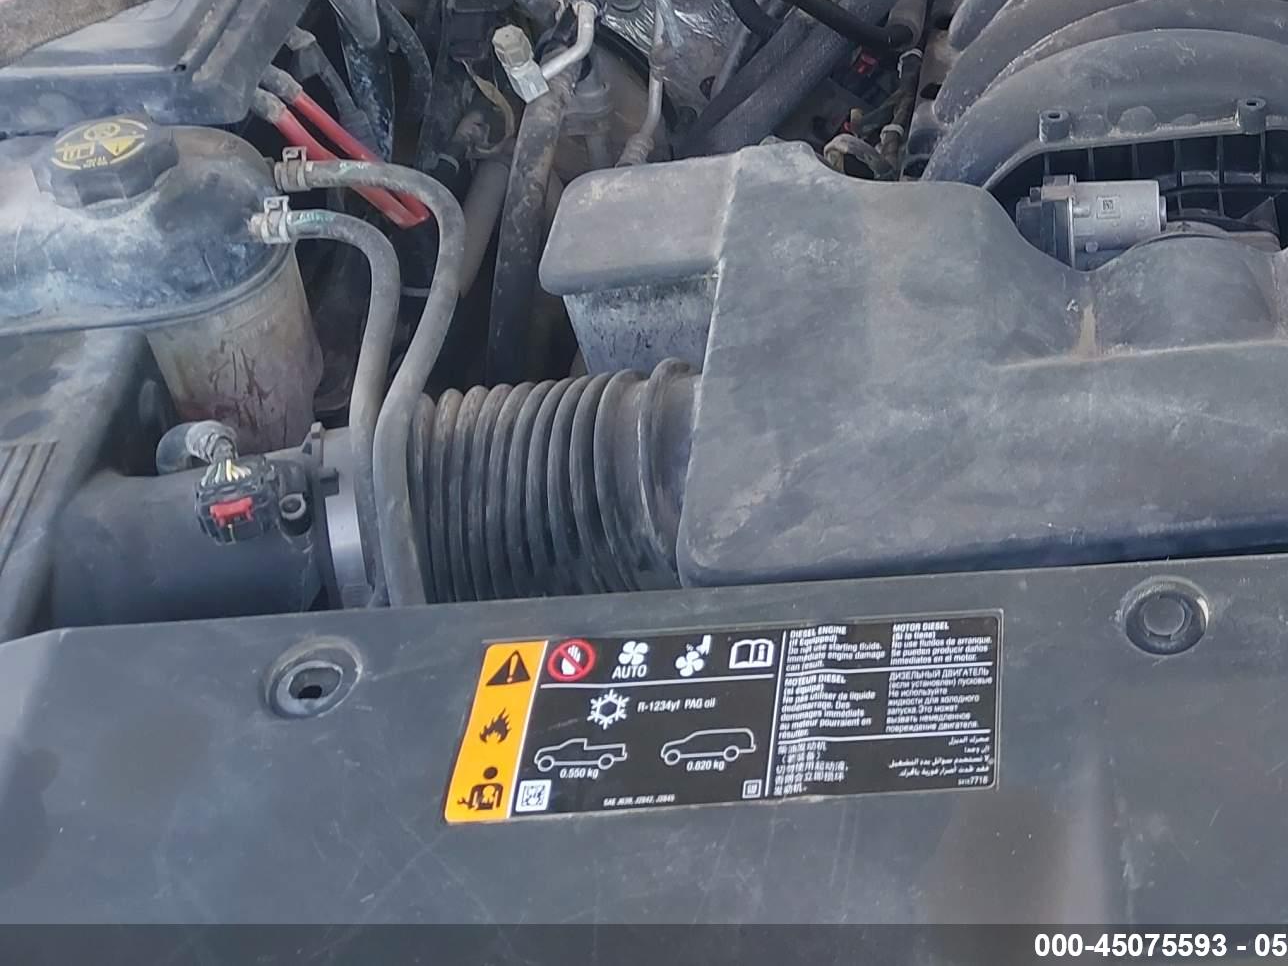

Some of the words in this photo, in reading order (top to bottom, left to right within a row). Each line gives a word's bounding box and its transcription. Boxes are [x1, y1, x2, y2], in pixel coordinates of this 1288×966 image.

[789, 628, 817, 639] DIESEL
[817, 625, 847, 635] ENGINE
[893, 622, 922, 632] MOTOR
[922, 621, 950, 631] DIESEL
[827, 651, 854, 662] engine
[854, 650, 886, 661] damage
[953, 654, 977, 663] motor.
[612, 664, 647, 680] AUTO
[889, 669, 941, 682] ДИЗЕЛЬНЫЙ
[941, 668, 989, 679] ДВИГАТЕЛЬ
[784, 675, 817, 687] MOTEUR
[818, 674, 847, 684] DIESEL
[637, 699, 681, 713] R-1234yf
[684, 697, 703, 710] PAG
[703, 697, 717, 709] oil
[713, 760, 726, 771] kg
[559, 767, 586, 779] 0.550
[586, 767, 600, 780] kg
